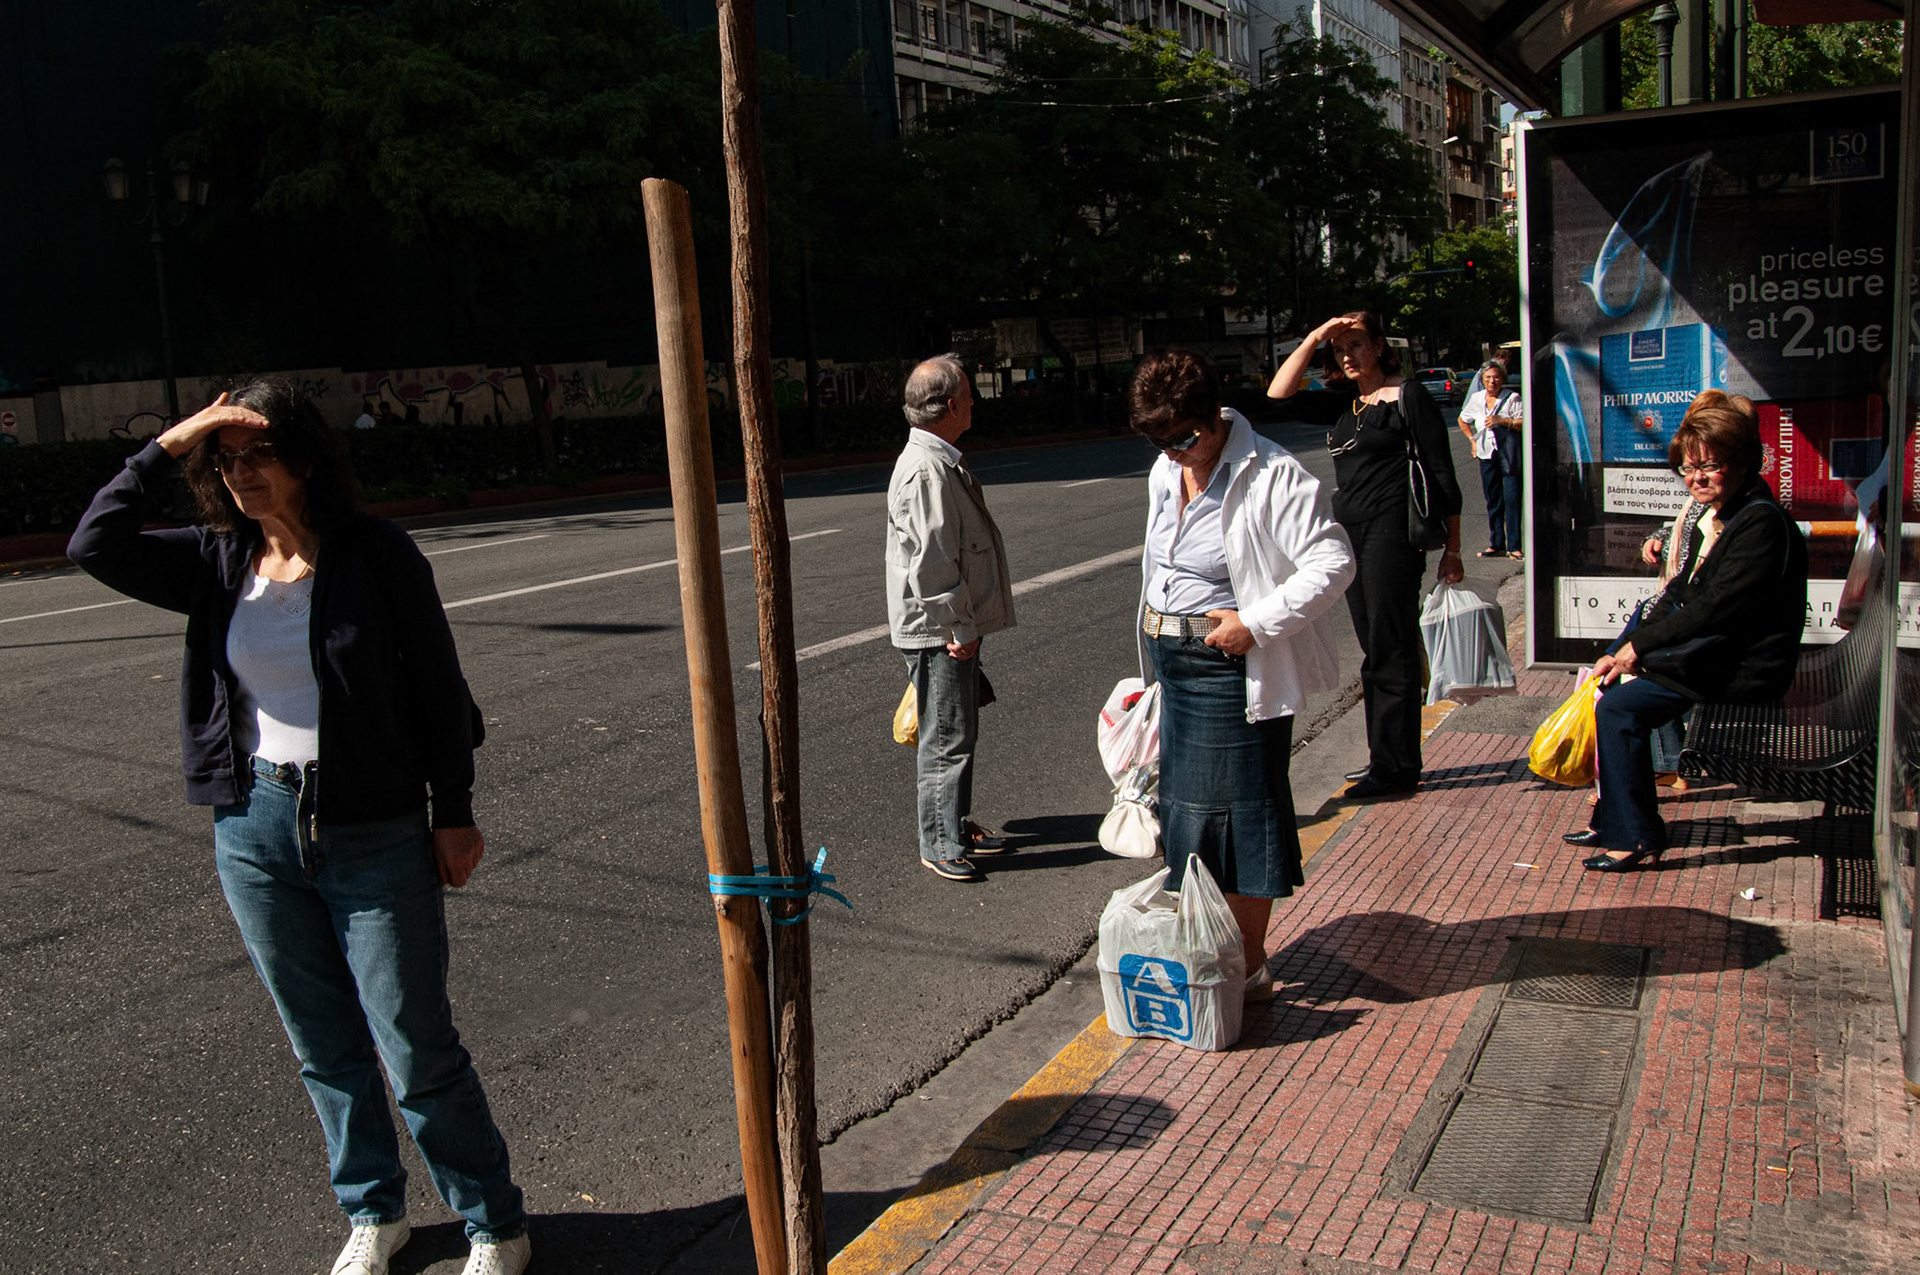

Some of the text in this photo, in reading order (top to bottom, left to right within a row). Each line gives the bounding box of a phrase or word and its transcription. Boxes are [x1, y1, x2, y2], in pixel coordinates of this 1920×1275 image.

[1826, 132, 1868, 158] 150
[1761, 244, 1884, 277] priceless
[1728, 274, 1884, 311] pleasure
[1747, 312, 1778, 340] at
[1603, 389, 1697, 407] PHILIP MORRIS
[1634, 443, 1663, 451] BLUES
[1779, 407, 1794, 511] PHILIP MORRIS
[1624, 473, 1675, 484] Το κάπνισμα
[1607, 486, 1690, 497] βλάπτει σοβαρά εσά
[1613, 499, 1625, 507] και
[1627, 500, 1646, 509] τους
[1648, 500, 1669, 510] γύρω
[1572, 597, 1599, 608] ΤΟ
